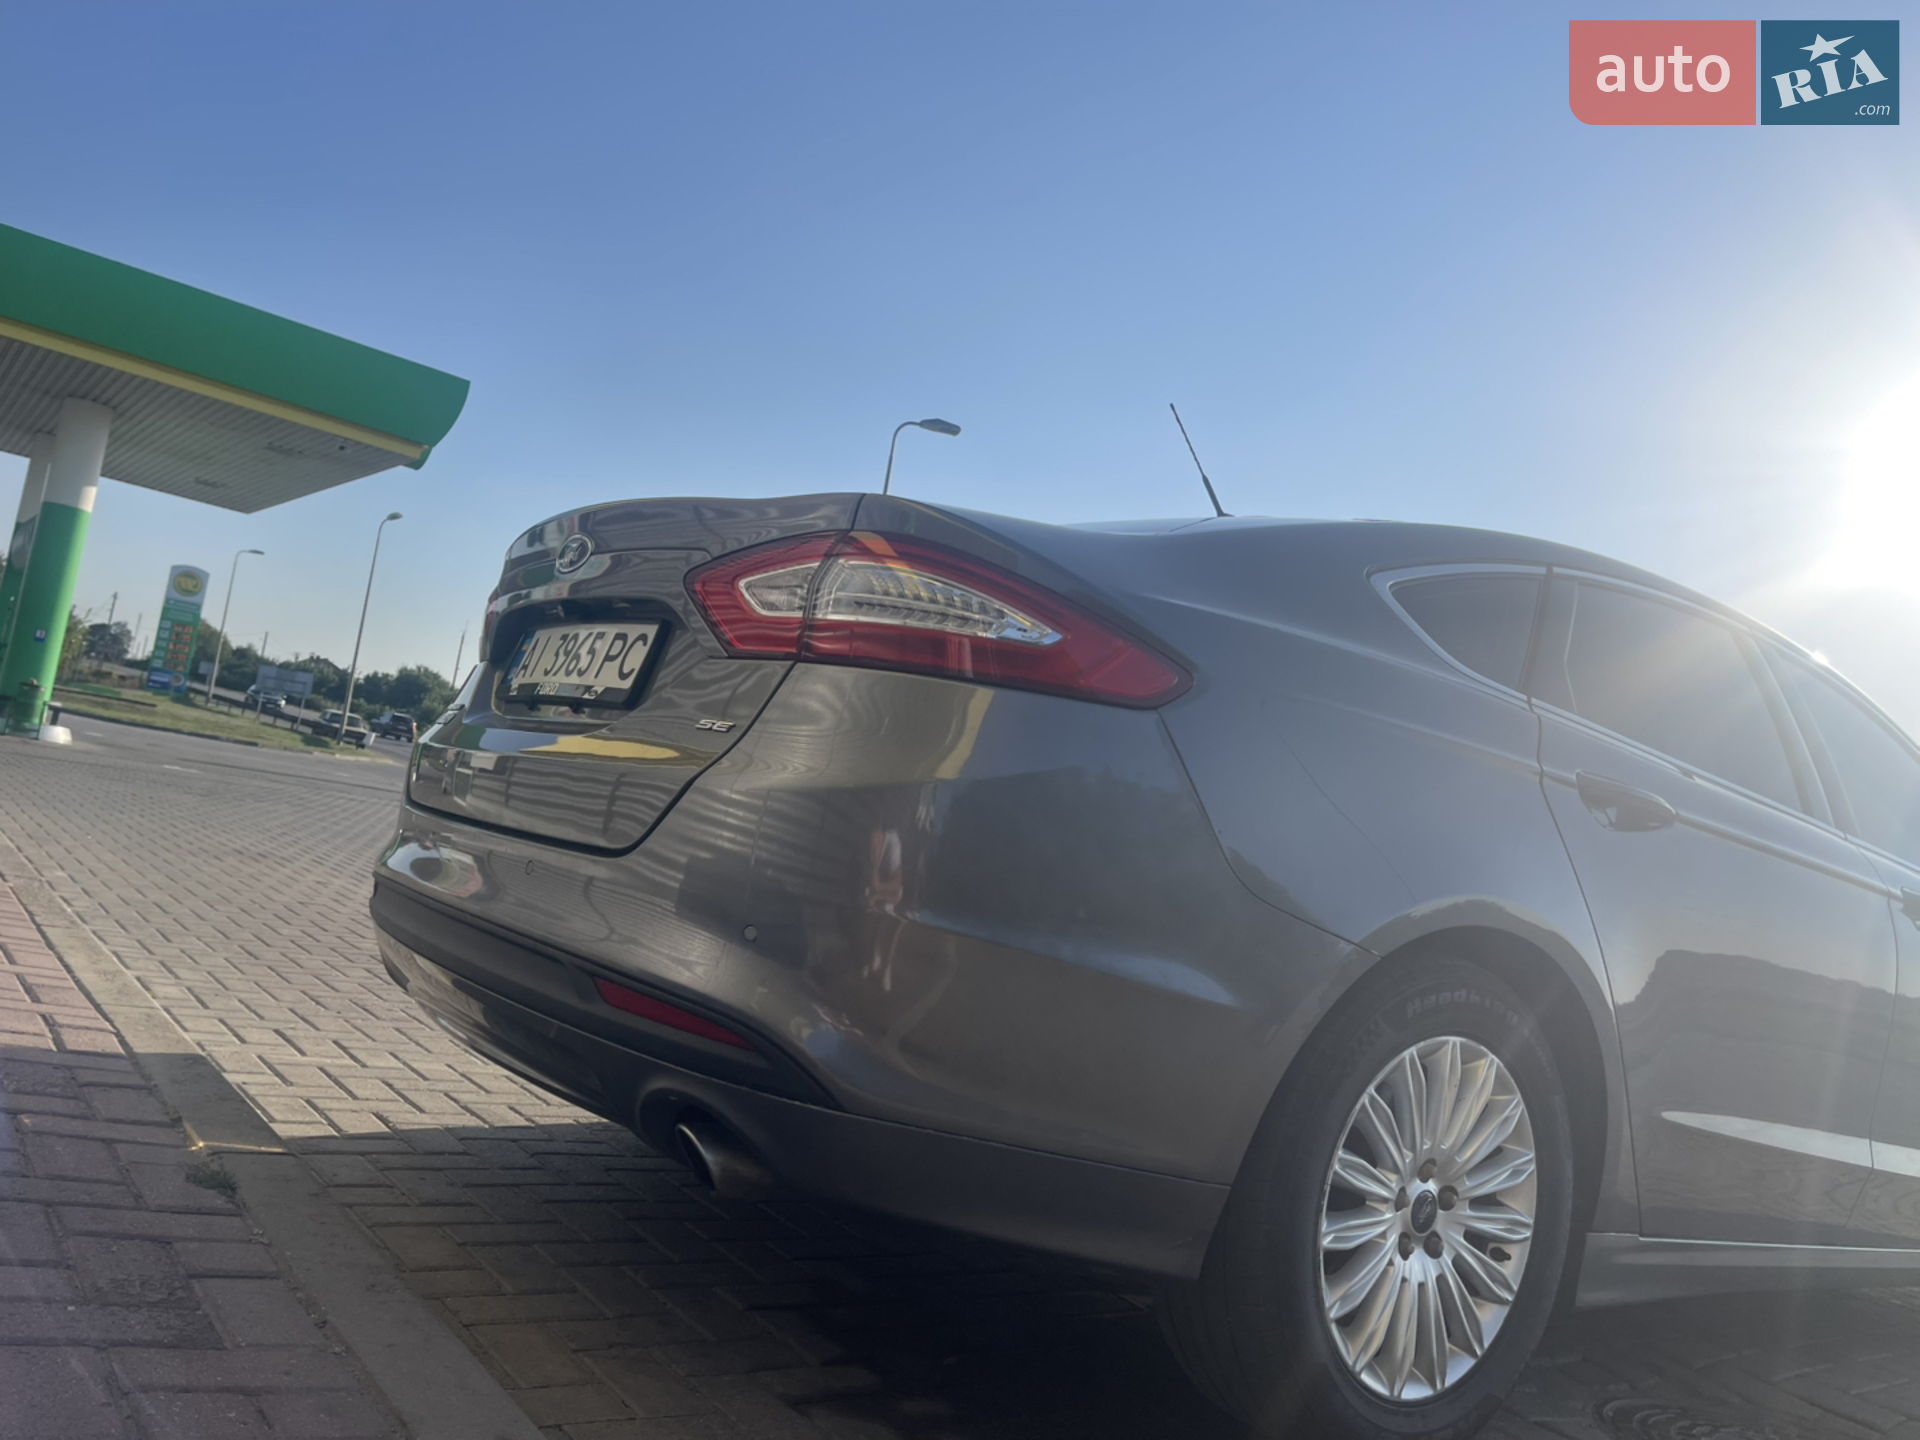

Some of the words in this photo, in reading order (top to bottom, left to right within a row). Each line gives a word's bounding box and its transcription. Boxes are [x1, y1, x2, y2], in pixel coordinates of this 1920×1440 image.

[516, 634, 552, 678] AI
[543, 631, 606, 678] 3965
[595, 632, 648, 680] PC
[695, 719, 735, 732] SE
